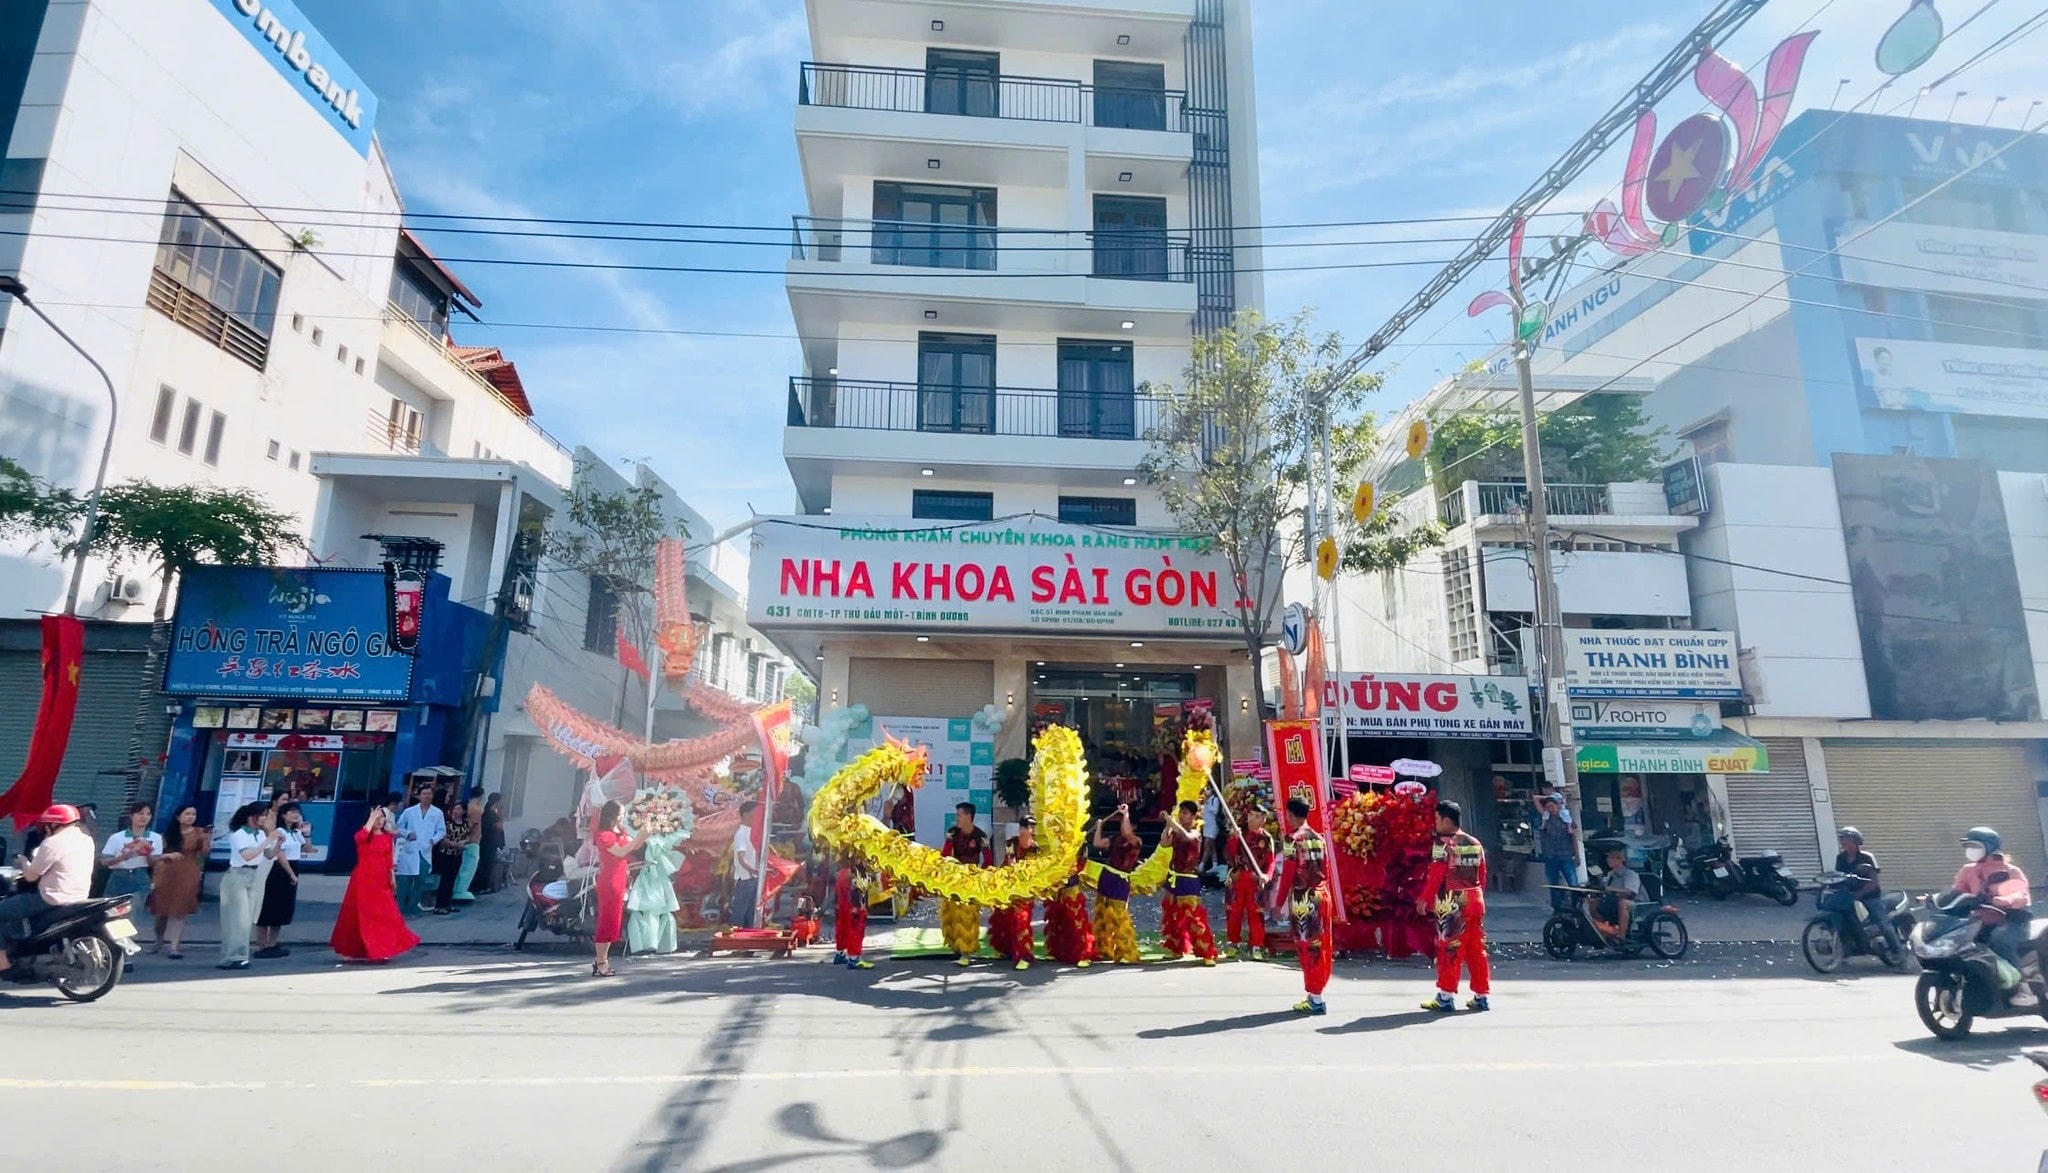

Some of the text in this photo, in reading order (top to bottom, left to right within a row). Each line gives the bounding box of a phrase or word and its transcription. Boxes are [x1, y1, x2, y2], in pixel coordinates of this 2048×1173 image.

[1545, 307, 1578, 342] ANH
[840, 522, 898, 542] PHÒNG
[904, 525, 953, 544] KHÁM
[959, 527, 1025, 546] CHUYÊN
[1030, 533, 1075, 547] KHOA
[779, 558, 874, 599] NHA
[891, 562, 1015, 603] KHOA
[1031, 553, 1110, 605] SÀI
[1124, 556, 1217, 608] GÒN
[766, 606, 791, 618] 431
[177, 618, 248, 653] HỒNG
[254, 624, 300, 655] TRÀ
[305, 627, 360, 657] NGÔ
[1579, 634, 1728, 648] NHÀ THUỐC ĐẠT CHUẨN GPP
[1584, 649, 1729, 670] THANH BÌNH
[1323, 674, 1459, 713] DŨNG
[1360, 717, 1383, 727] MUA
[1386, 716, 1407, 728] BÁN
[1410, 718, 1430, 730] PHỤ
[1434, 717, 1461, 729] TÙNG
[1464, 719, 1476, 728] XE
[1480, 717, 1501, 729] GẮN
[1503, 718, 1525, 730] MÁY
[1620, 758, 1668, 772] THANH
[1672, 756, 1703, 772] BÌNH
